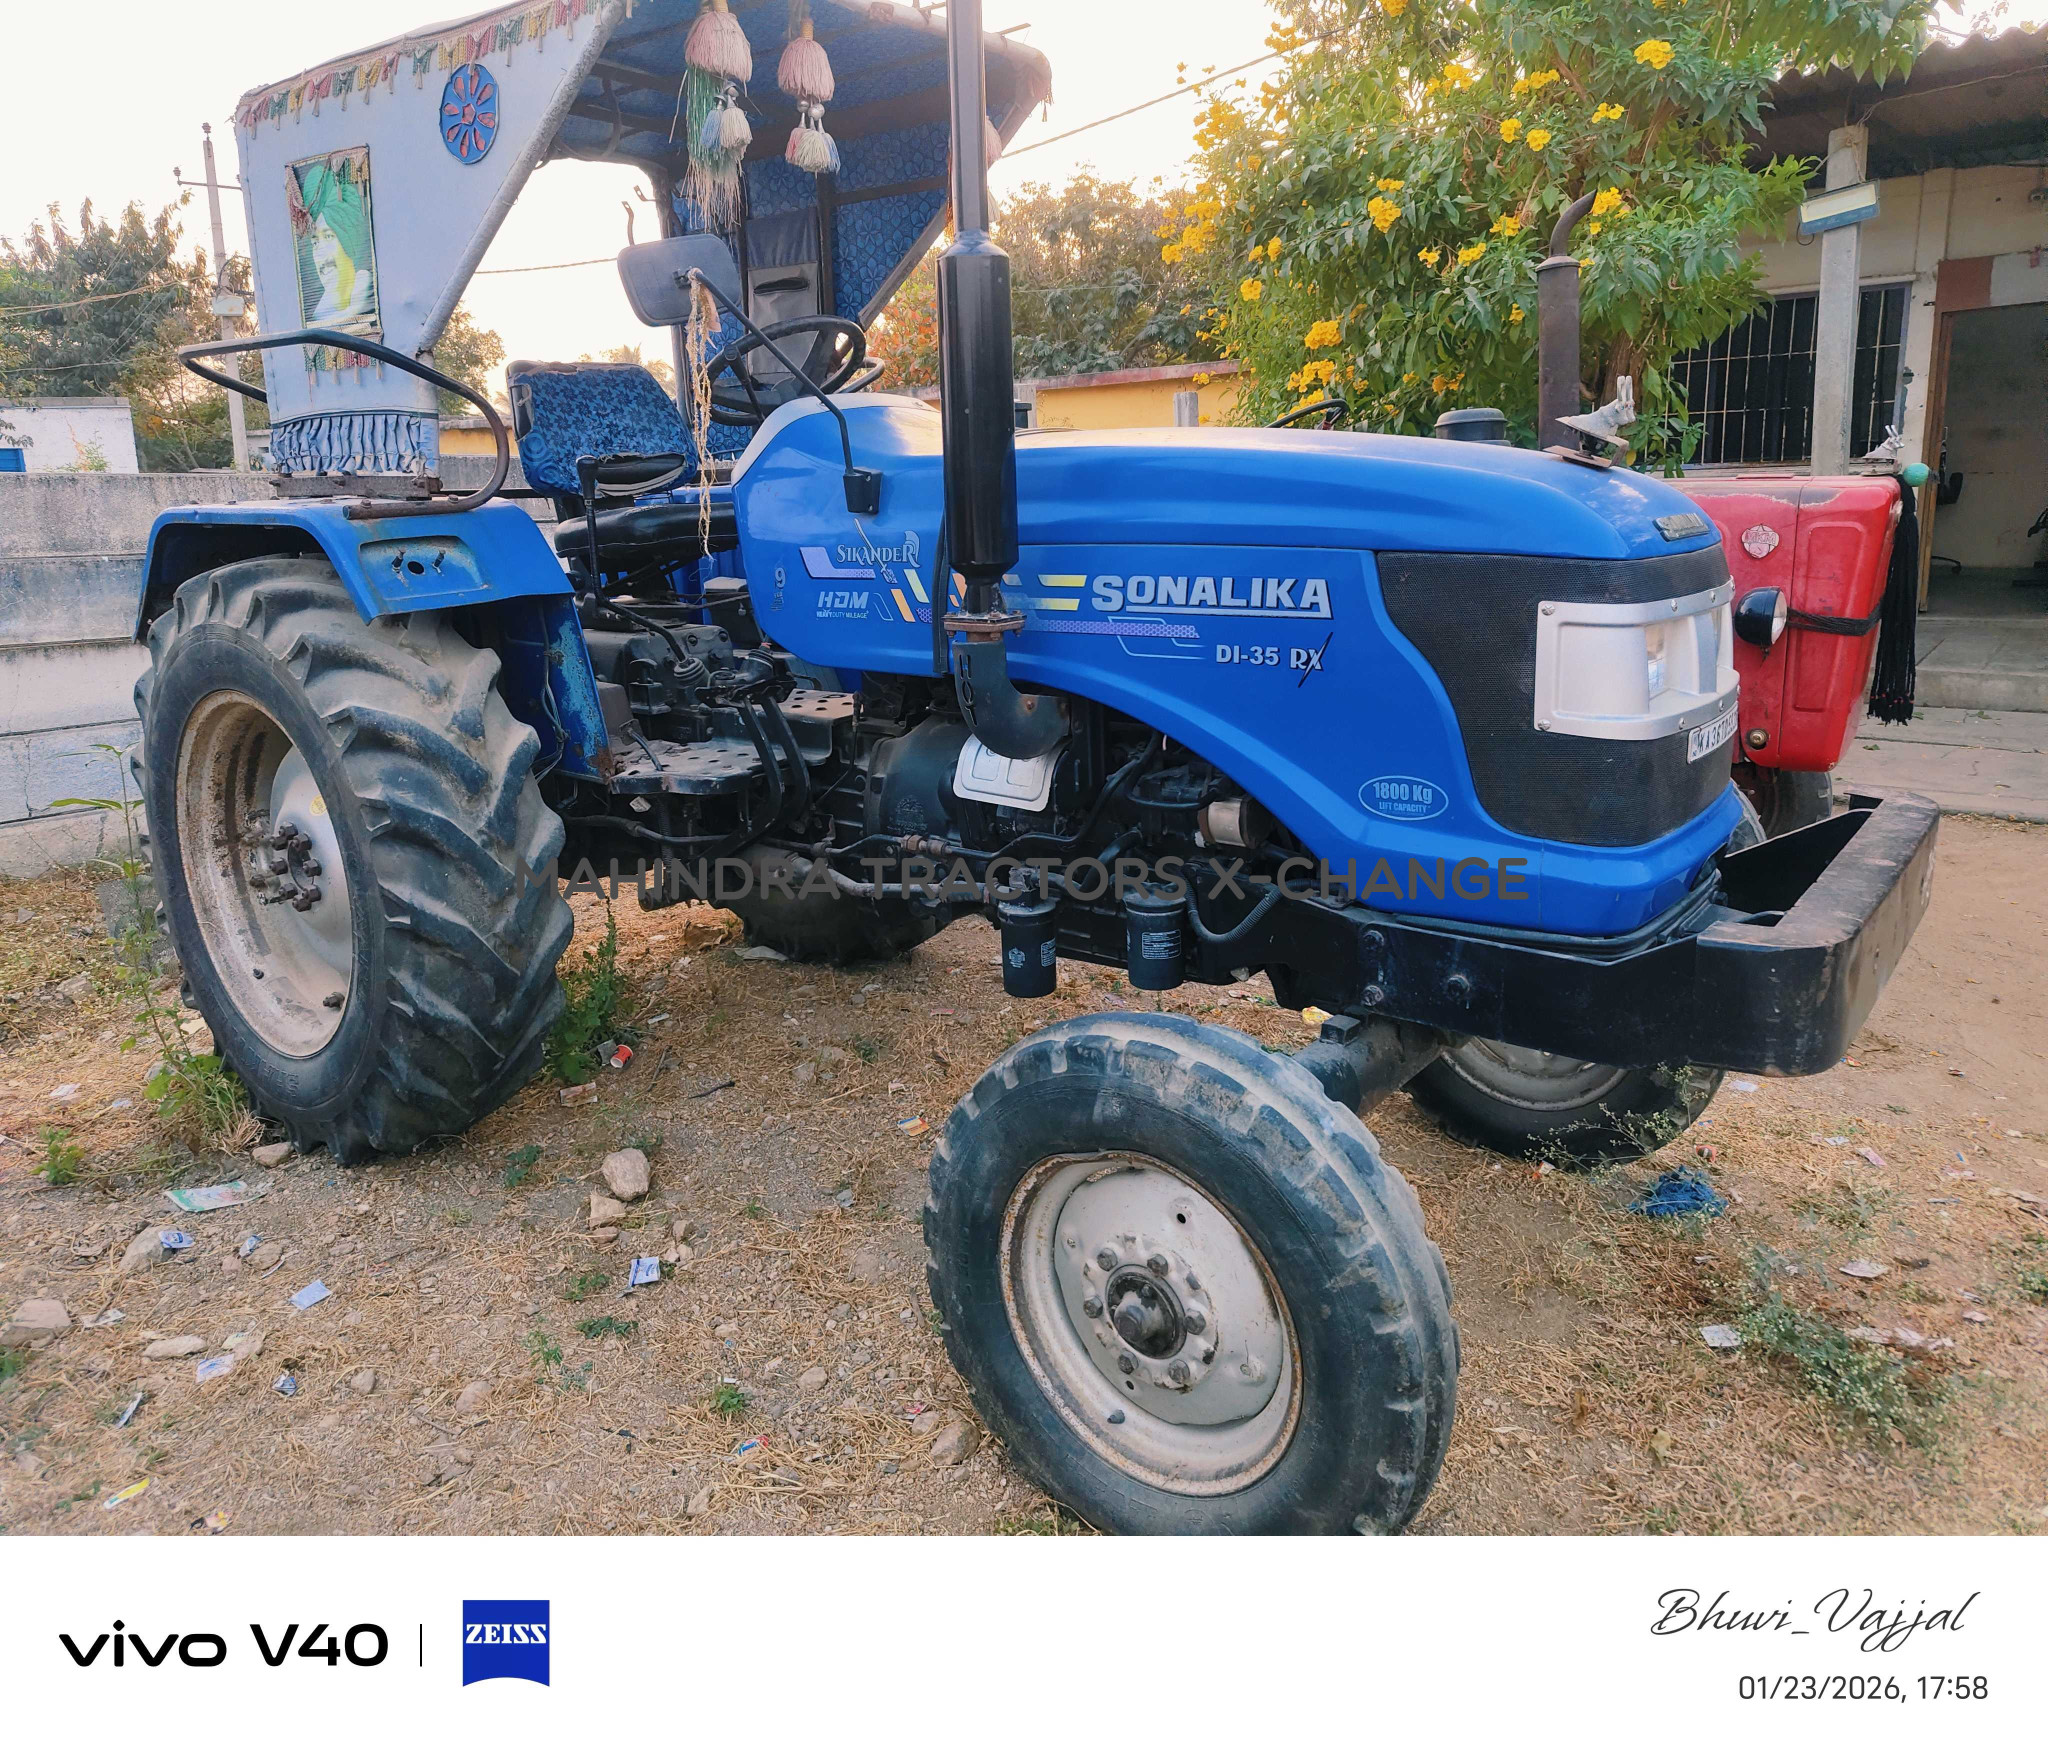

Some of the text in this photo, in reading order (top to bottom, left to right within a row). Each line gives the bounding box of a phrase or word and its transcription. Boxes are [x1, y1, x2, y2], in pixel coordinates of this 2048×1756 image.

[836, 538, 920, 567] SIKANDER
[817, 591, 870, 610] HDM
[1092, 575, 1334, 620] SONALIKA
[1216, 639, 1328, 678] DI-35 RX
[1373, 782, 1433, 804] 1800 Kg
[1379, 802, 1427, 813] LIFT CAPACITY
